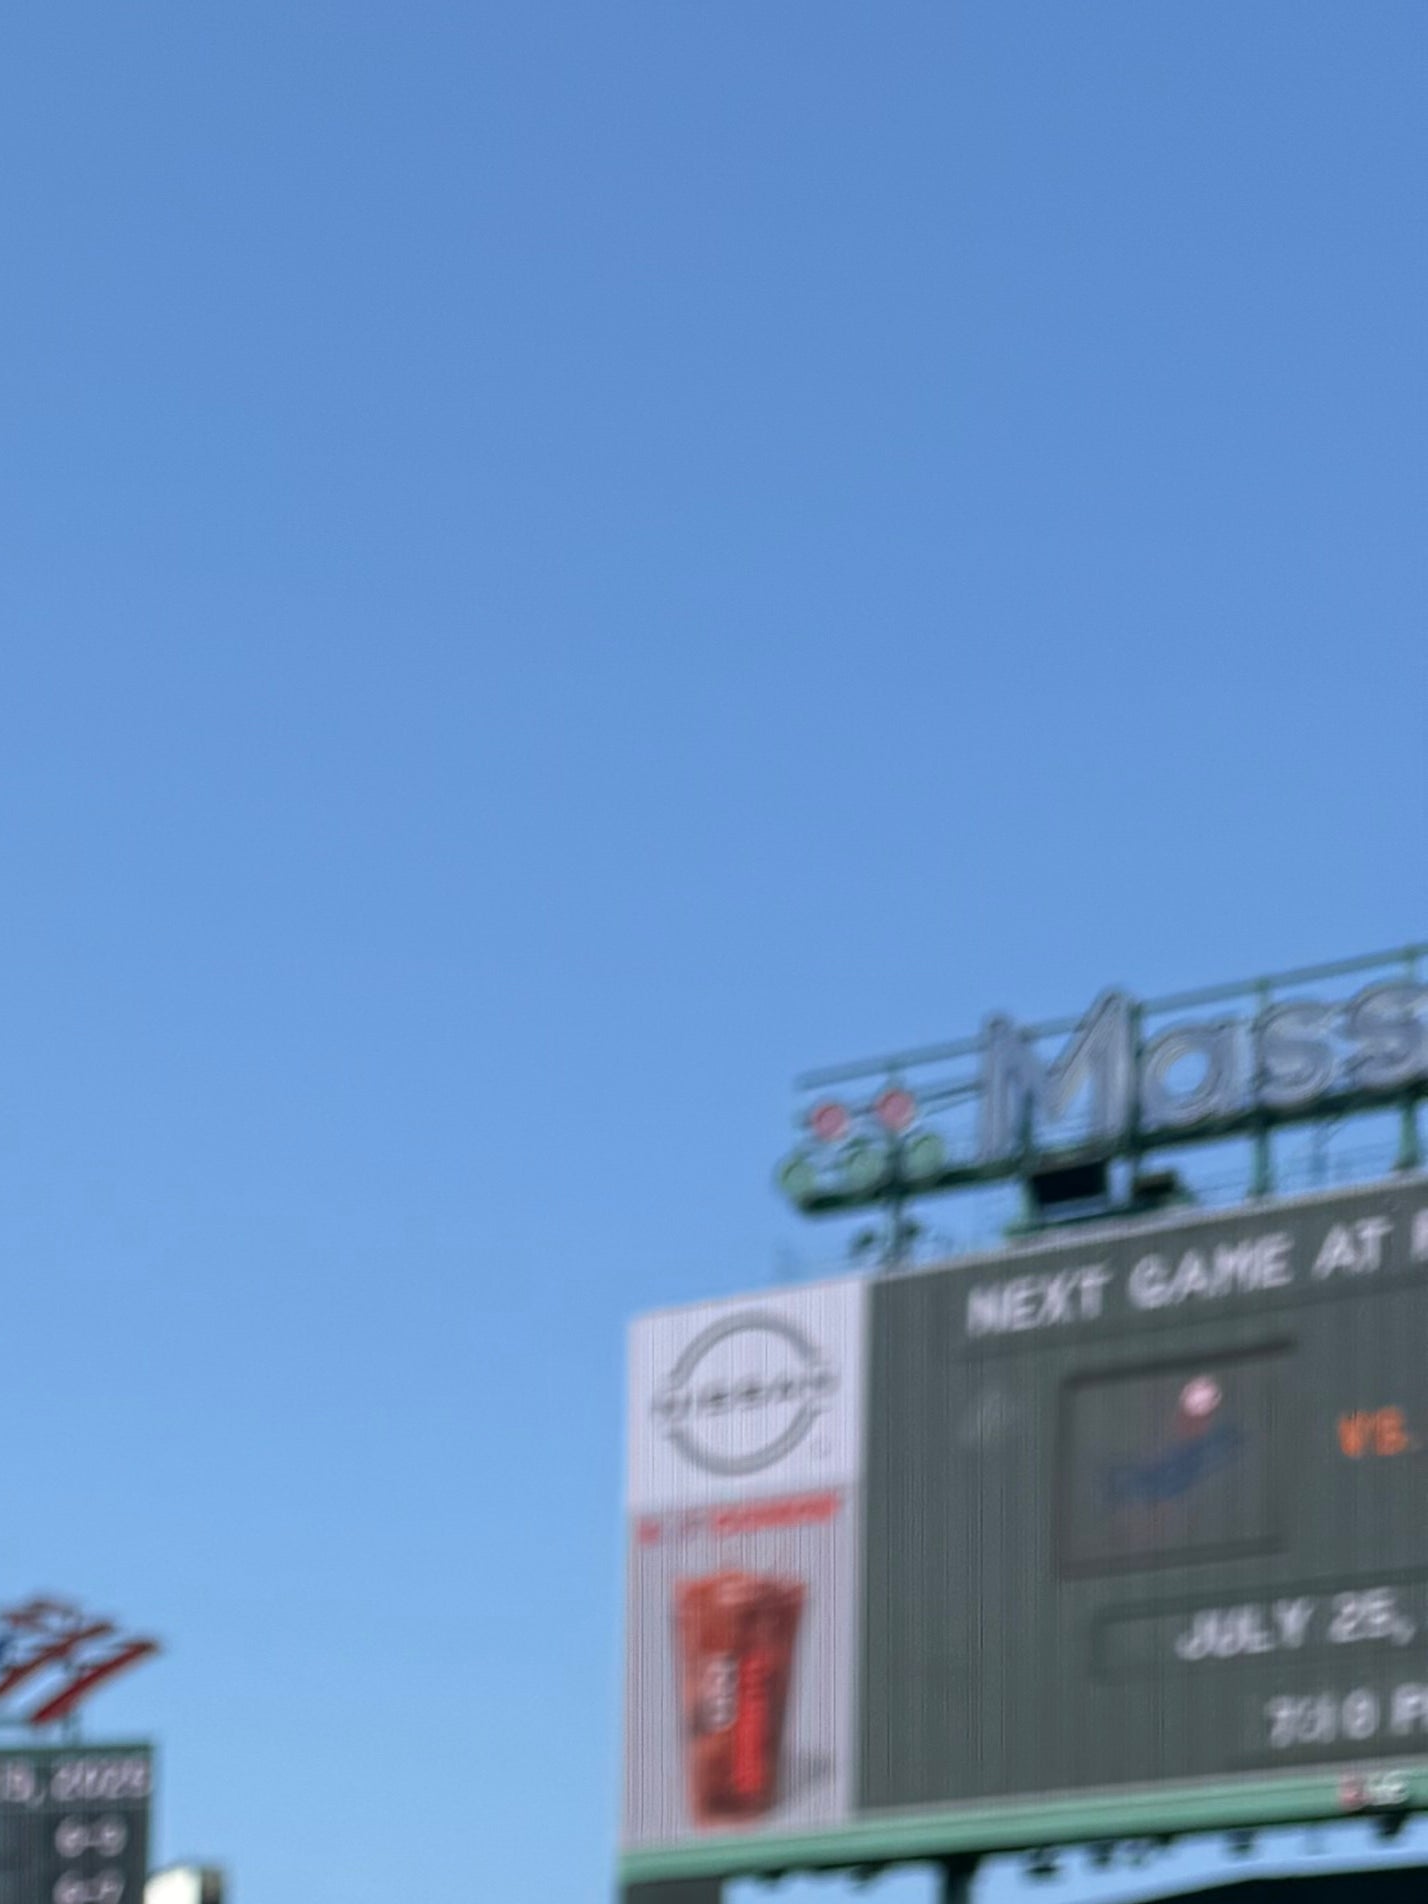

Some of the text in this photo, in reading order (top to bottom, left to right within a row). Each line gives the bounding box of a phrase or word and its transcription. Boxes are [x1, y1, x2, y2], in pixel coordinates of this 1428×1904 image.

[966, 1262, 1112, 1337] NEXT
[1127, 1232, 1297, 1309] GAME
[1311, 1216, 1393, 1281] AT
[1175, 1594, 1314, 1660] JULY
